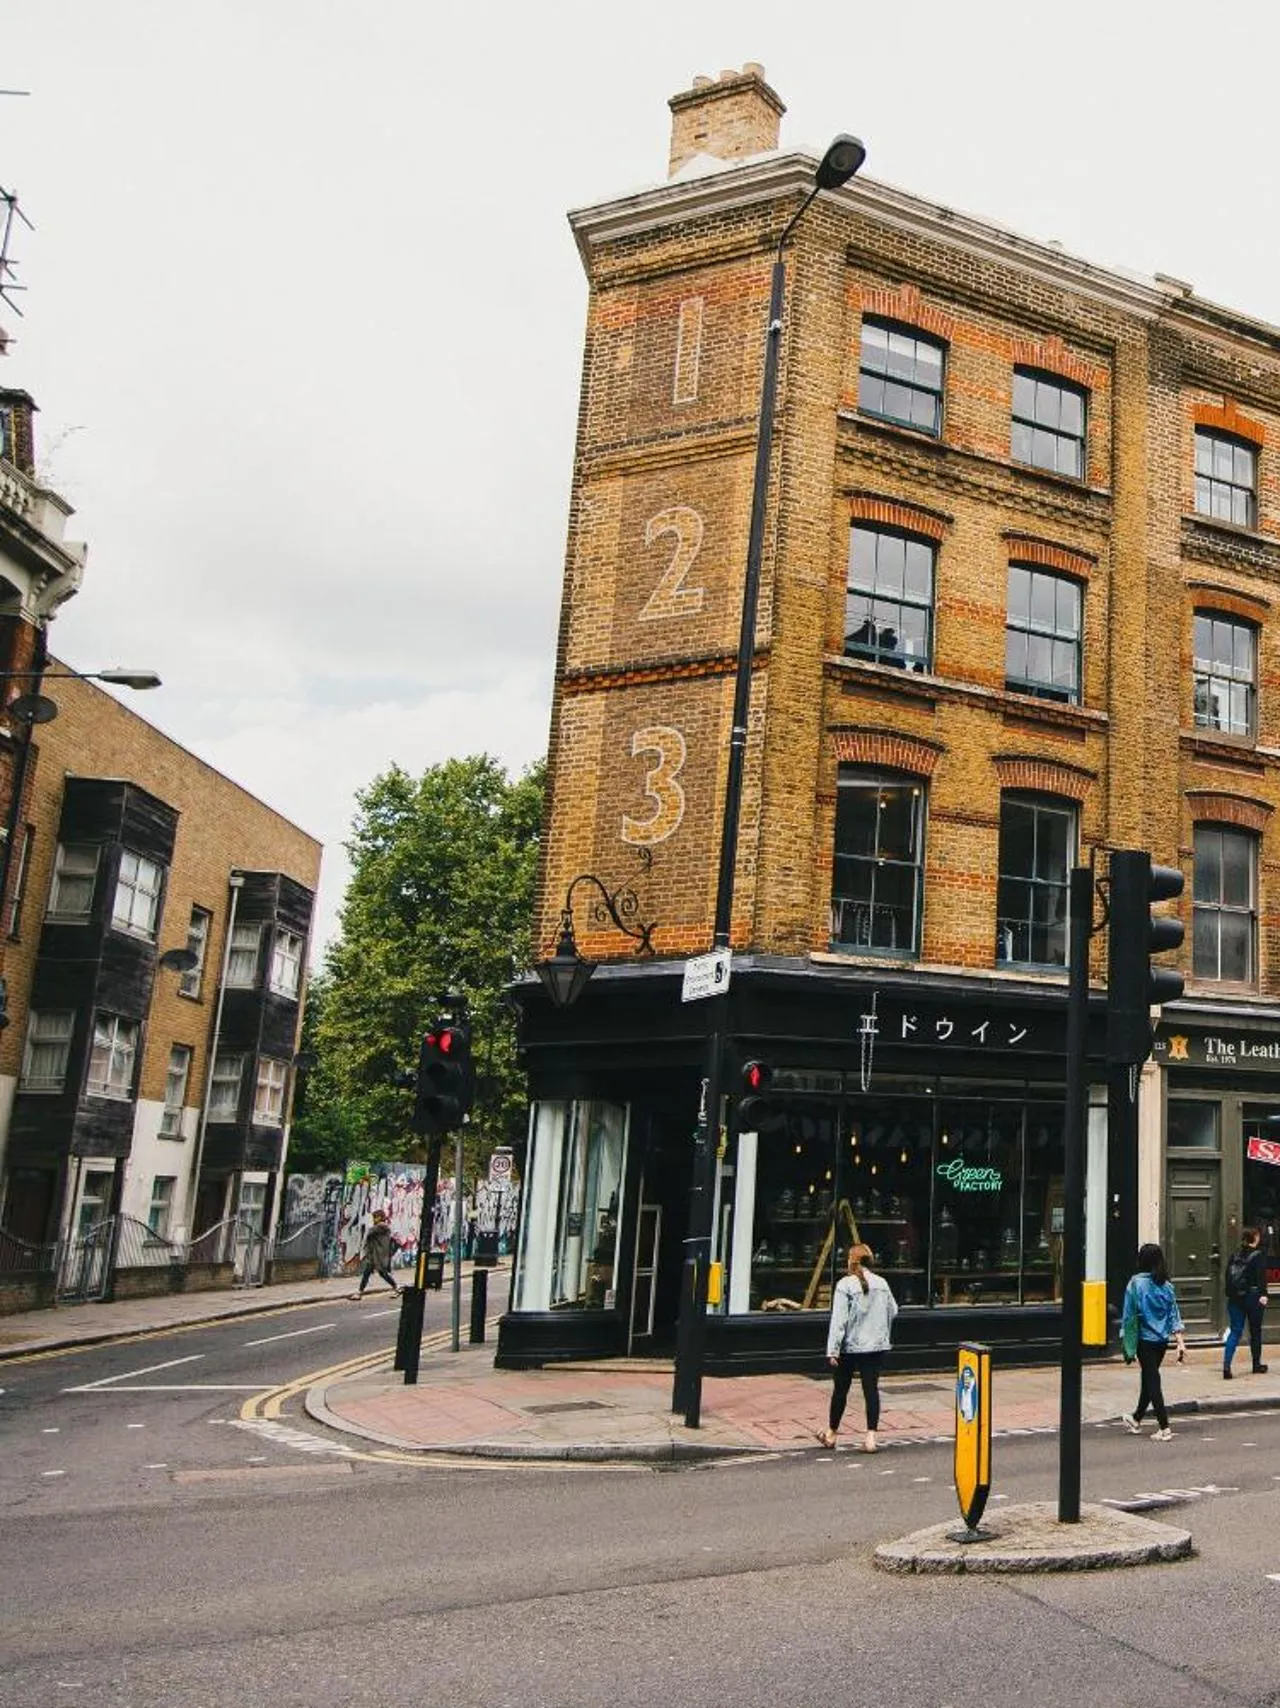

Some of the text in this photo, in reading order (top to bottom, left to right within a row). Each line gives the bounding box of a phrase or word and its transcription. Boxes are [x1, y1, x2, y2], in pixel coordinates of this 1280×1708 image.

[637, 505, 705, 623] 2
[620, 726, 687, 846] 3
[1204, 1037, 1235, 1055] The
[960, 1180, 1003, 1192] FACTORY
